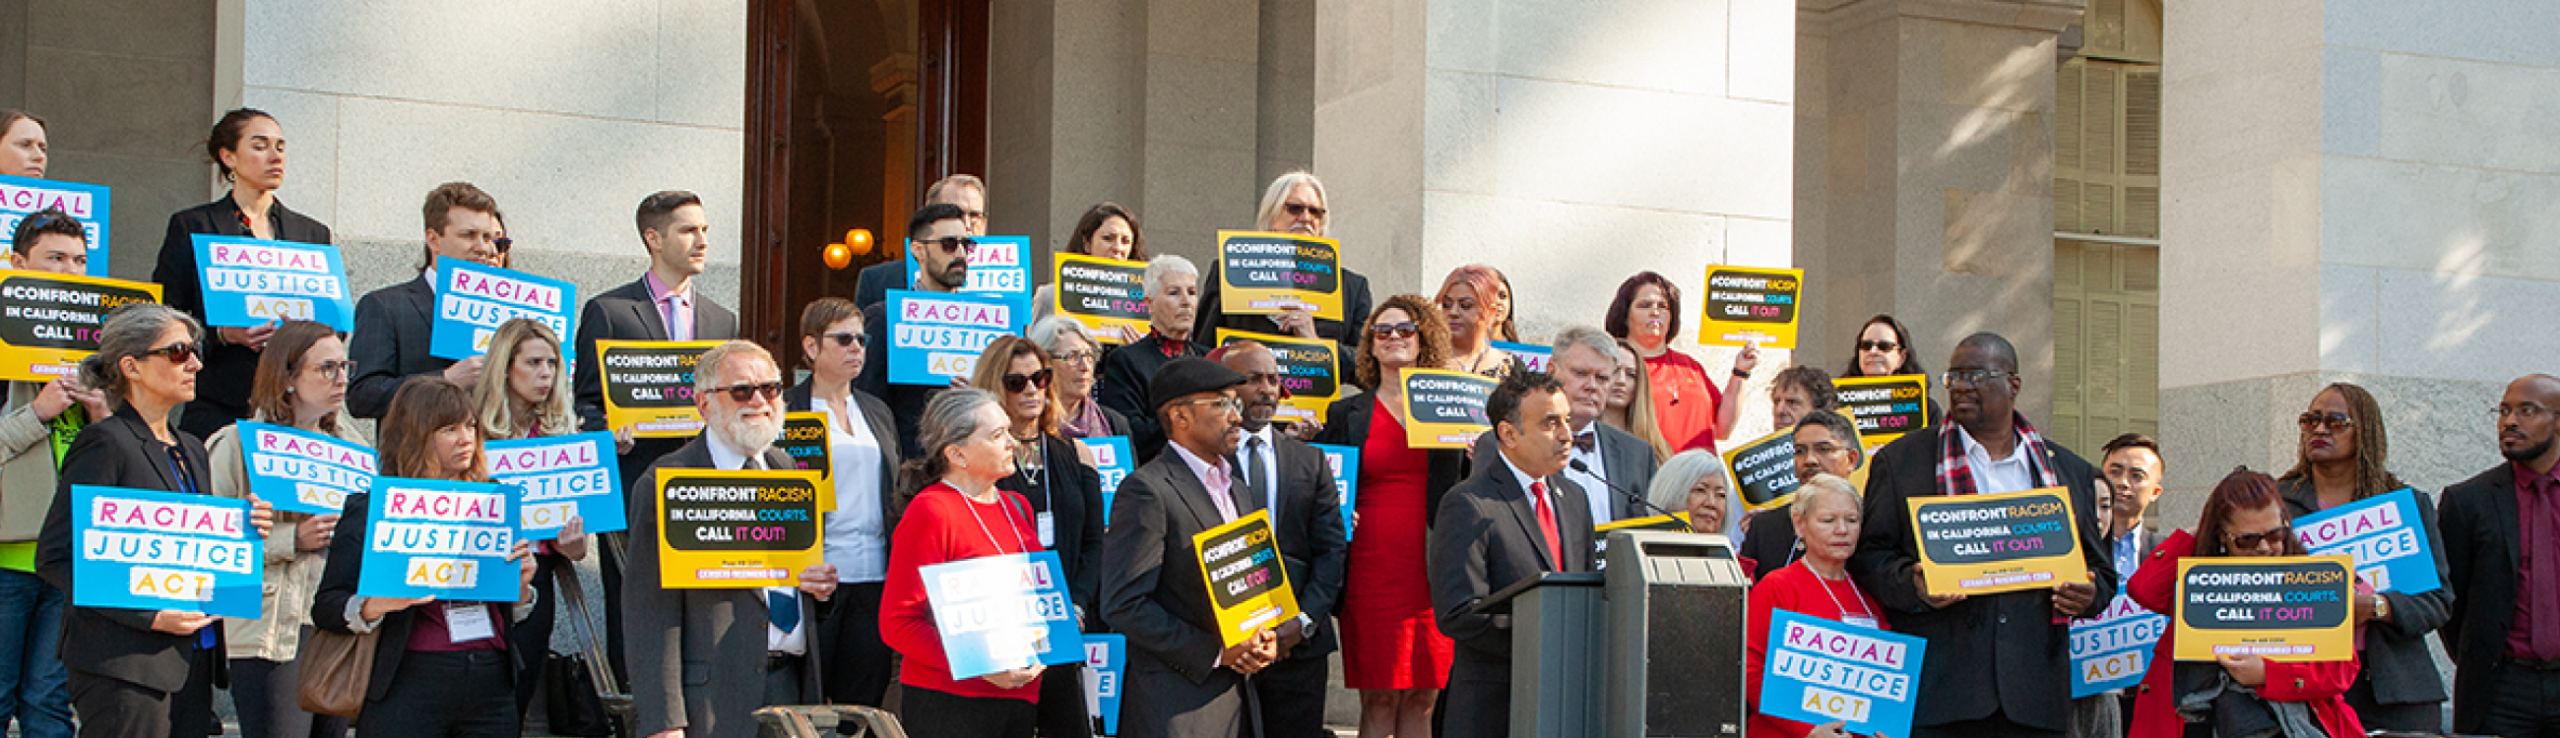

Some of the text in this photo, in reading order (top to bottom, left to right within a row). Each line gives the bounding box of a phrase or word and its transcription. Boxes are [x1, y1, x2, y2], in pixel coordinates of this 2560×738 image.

[216, 246, 322, 269] RACIAL
[967, 247, 1014, 264] CIAL
[1229, 259, 1239, 268] IN
[1241, 259, 1297, 269] CALIFORNIA
[215, 271, 335, 294] JUSTICE
[1249, 271, 1318, 285] CALL IT OUT!
[455, 272, 555, 308] RACIAL
[1064, 282, 1074, 291] IN
[1075, 283, 1128, 298] CALIFORNIA
[1720, 291, 1764, 303] CALIFORNIA
[251, 300, 307, 318] ACT
[1082, 296, 1110, 311] CALL
[1111, 299, 1122, 311] IT
[1724, 304, 1749, 316] CALL
[1750, 305, 1760, 316] IT
[6, 306, 20, 318] IN
[22, 306, 99, 325] CALIFORNIA
[905, 301, 1004, 326] RACIAL
[33, 325, 73, 341] CALL
[76, 329, 89, 342] IT
[901, 329, 998, 348] JUSTIC
[931, 356, 969, 373] AC
[609, 373, 622, 384] IN
[623, 373, 682, 385] CALIFORNIA
[631, 388, 663, 401] CALL
[663, 386, 675, 399] IT
[1413, 394, 1486, 408] IN CALIFORNIA
[1435, 406, 1468, 418] CALL
[1469, 407, 1480, 419] IT
[264, 433, 372, 471] RACIAL
[495, 445, 592, 471] ACIAL
[262, 458, 370, 490] JUSTIC
[1767, 473, 1800, 492] CALL
[520, 472, 604, 497] STICE
[666, 485, 811, 503] #CONFRONTRACISM
[303, 488, 342, 508] AC
[391, 492, 499, 518] RACIAL
[100, 501, 237, 533] RACIAL
[521, 505, 571, 526] CT
[670, 508, 810, 521] IN CALIFORNIA COURTS.
[695, 526, 786, 541] CALL IT OUT!
[1926, 520, 2064, 540] IN CALIFORNIA COURTS.
[2300, 507, 2394, 546] ACIAL
[380, 527, 508, 553] JUSTICE
[1953, 536, 2045, 556] CALL IT OUT!
[92, 535, 248, 568] JUSTICE
[410, 562, 473, 584] ACT
[2187, 570, 2344, 586] #CONFRONTRACISM
[135, 572, 207, 597] ACT
[1227, 577, 1249, 596] CALL
[2190, 590, 2340, 604] IN CALIFORNIA COURTS.
[2215, 606, 2314, 621] CALL IT OUT!
[1788, 626, 1897, 665] RACIAL
[2070, 620, 2162, 655] USTICE
[1779, 655, 1905, 697] JUSTICE
[2086, 653, 2136, 681] ACT
[1805, 692, 1866, 718] ACT
